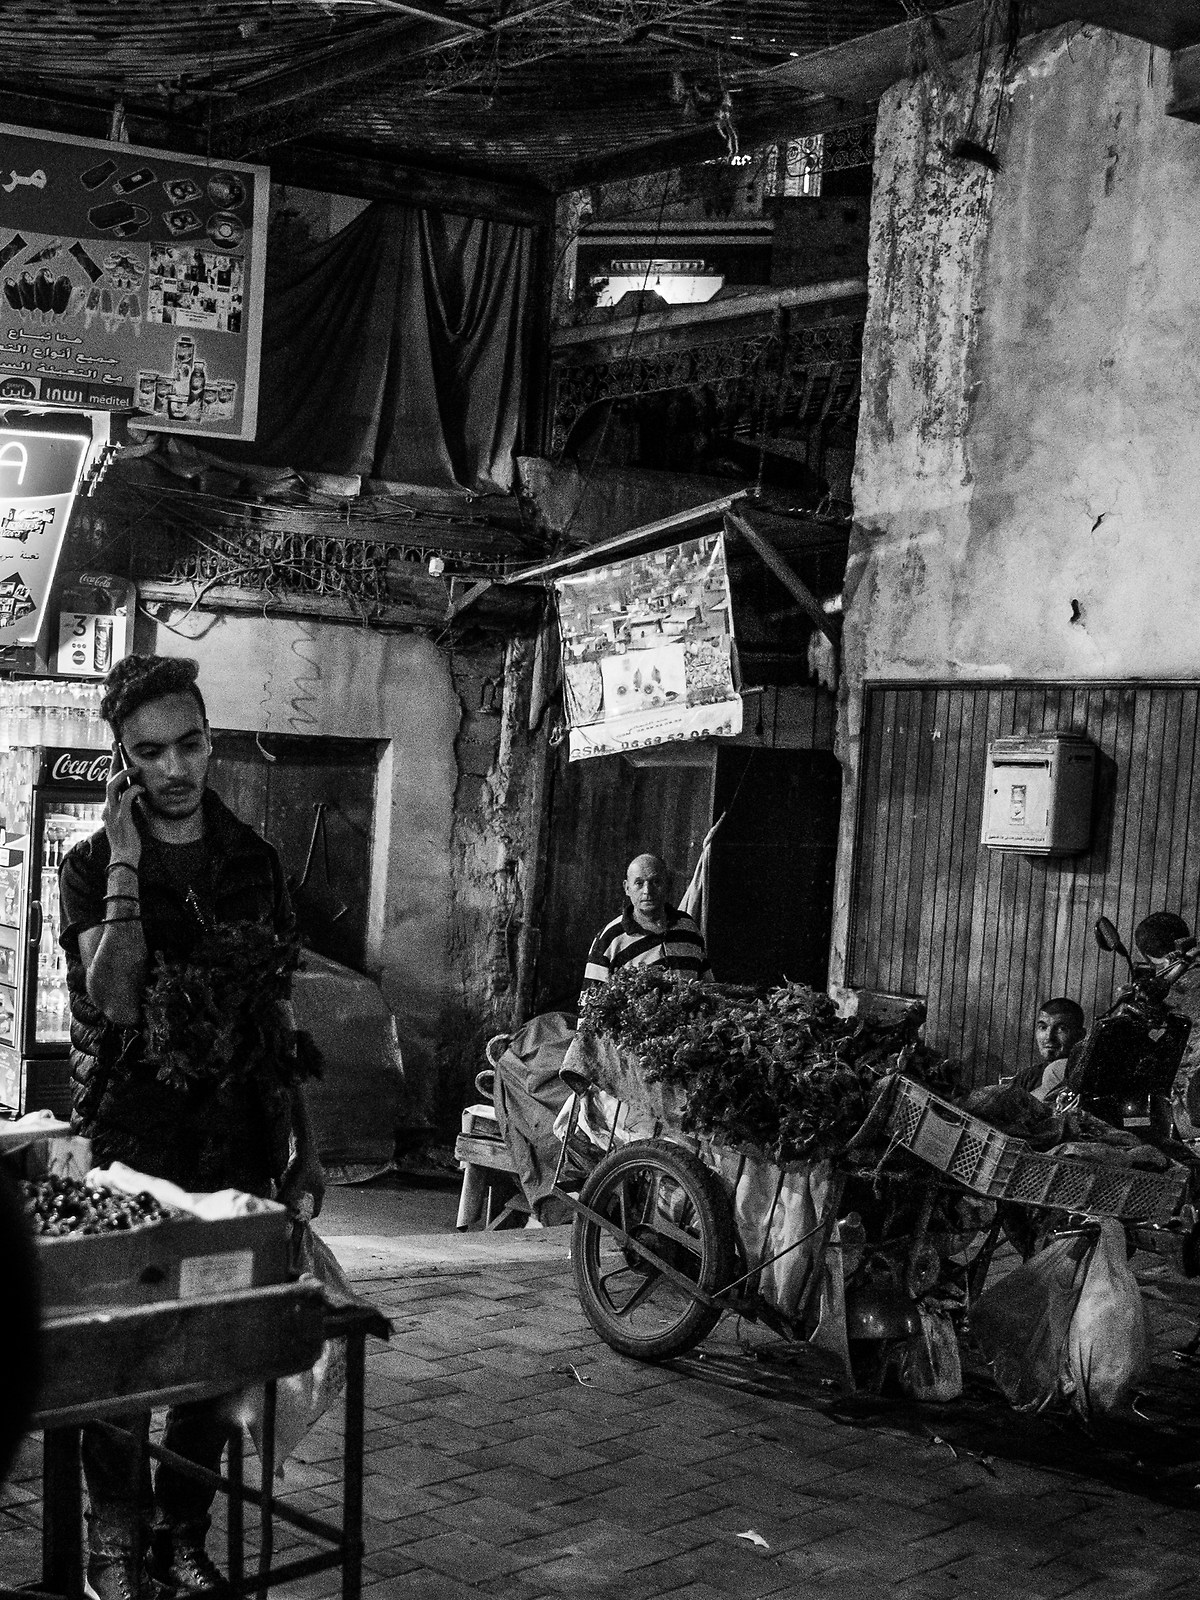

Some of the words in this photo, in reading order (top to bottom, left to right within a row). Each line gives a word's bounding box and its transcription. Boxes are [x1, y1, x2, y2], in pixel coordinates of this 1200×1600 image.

[7, 328, 52, 341] تباع
[56, 332, 83, 345] هنا
[32, 346, 71, 359] أنواع
[75, 353, 119, 366] جميع
[36, 363, 97, 379] التعبئة
[102, 372, 123, 384] مع
[89, 394, 130, 407] méditel
[72, 614, 88, 637] 3
[52, 753, 112, 782] Coca-Co
